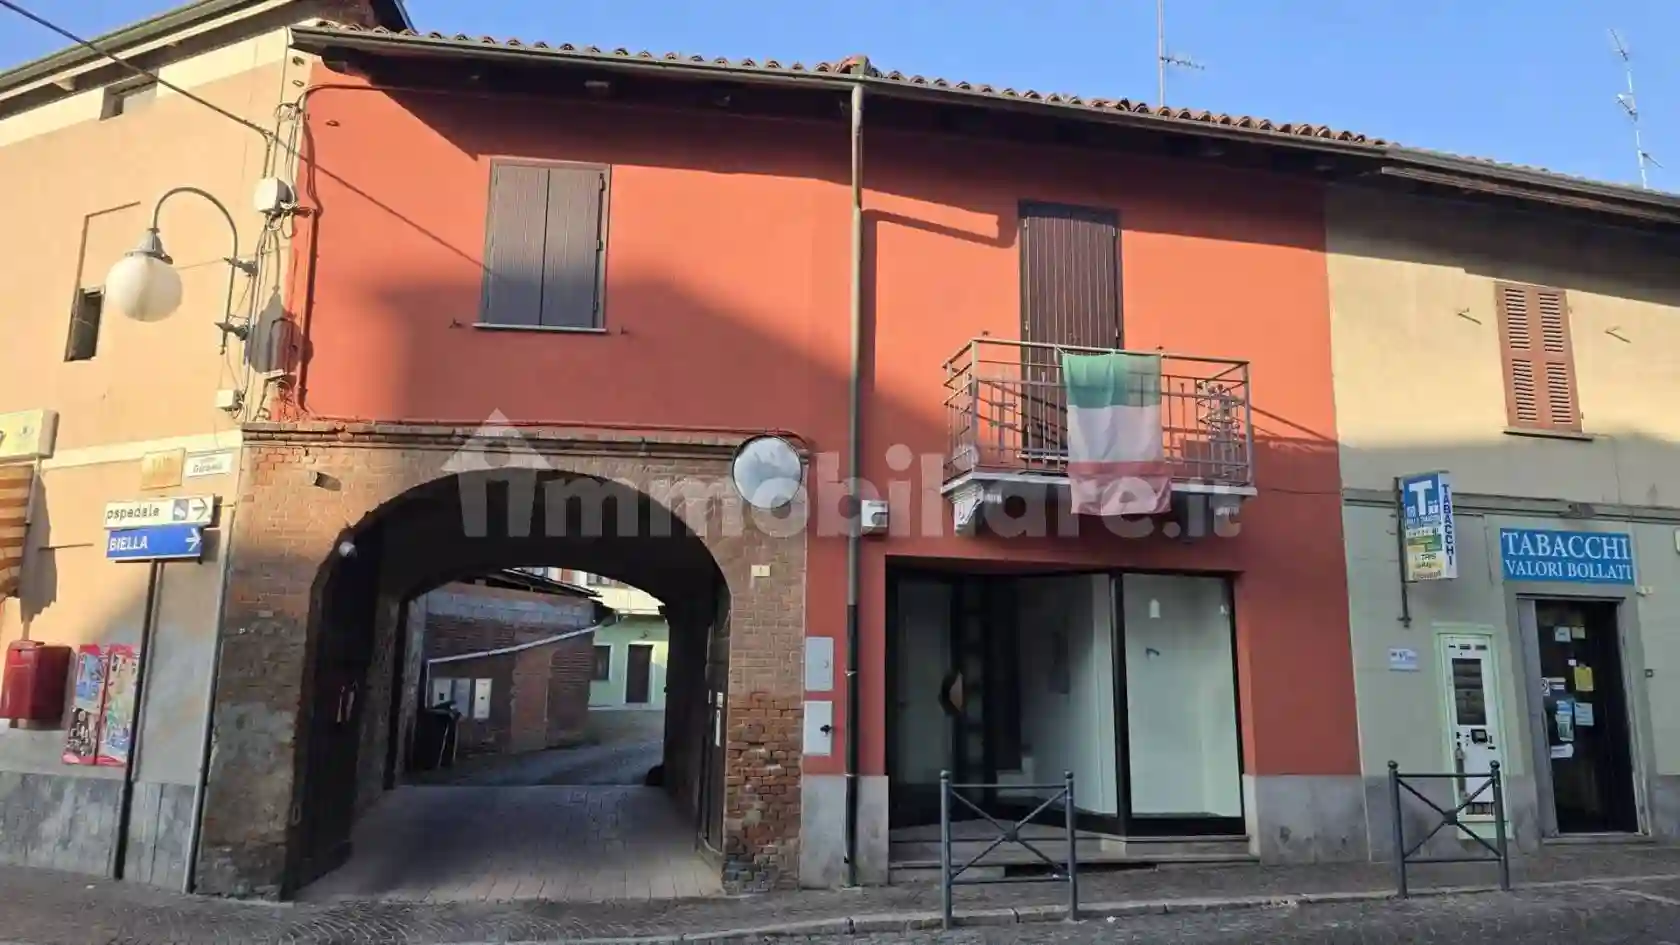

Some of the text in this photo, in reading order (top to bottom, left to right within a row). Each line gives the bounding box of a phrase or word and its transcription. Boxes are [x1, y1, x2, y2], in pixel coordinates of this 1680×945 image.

[106, 504, 159, 520] ospedale
[1441, 484, 1454, 566] TABACCHI
[109, 536, 148, 551] BIELLA
[1502, 531, 1632, 561] TABACCHI
[1505, 559, 1633, 580] VALORI BOLLATI
